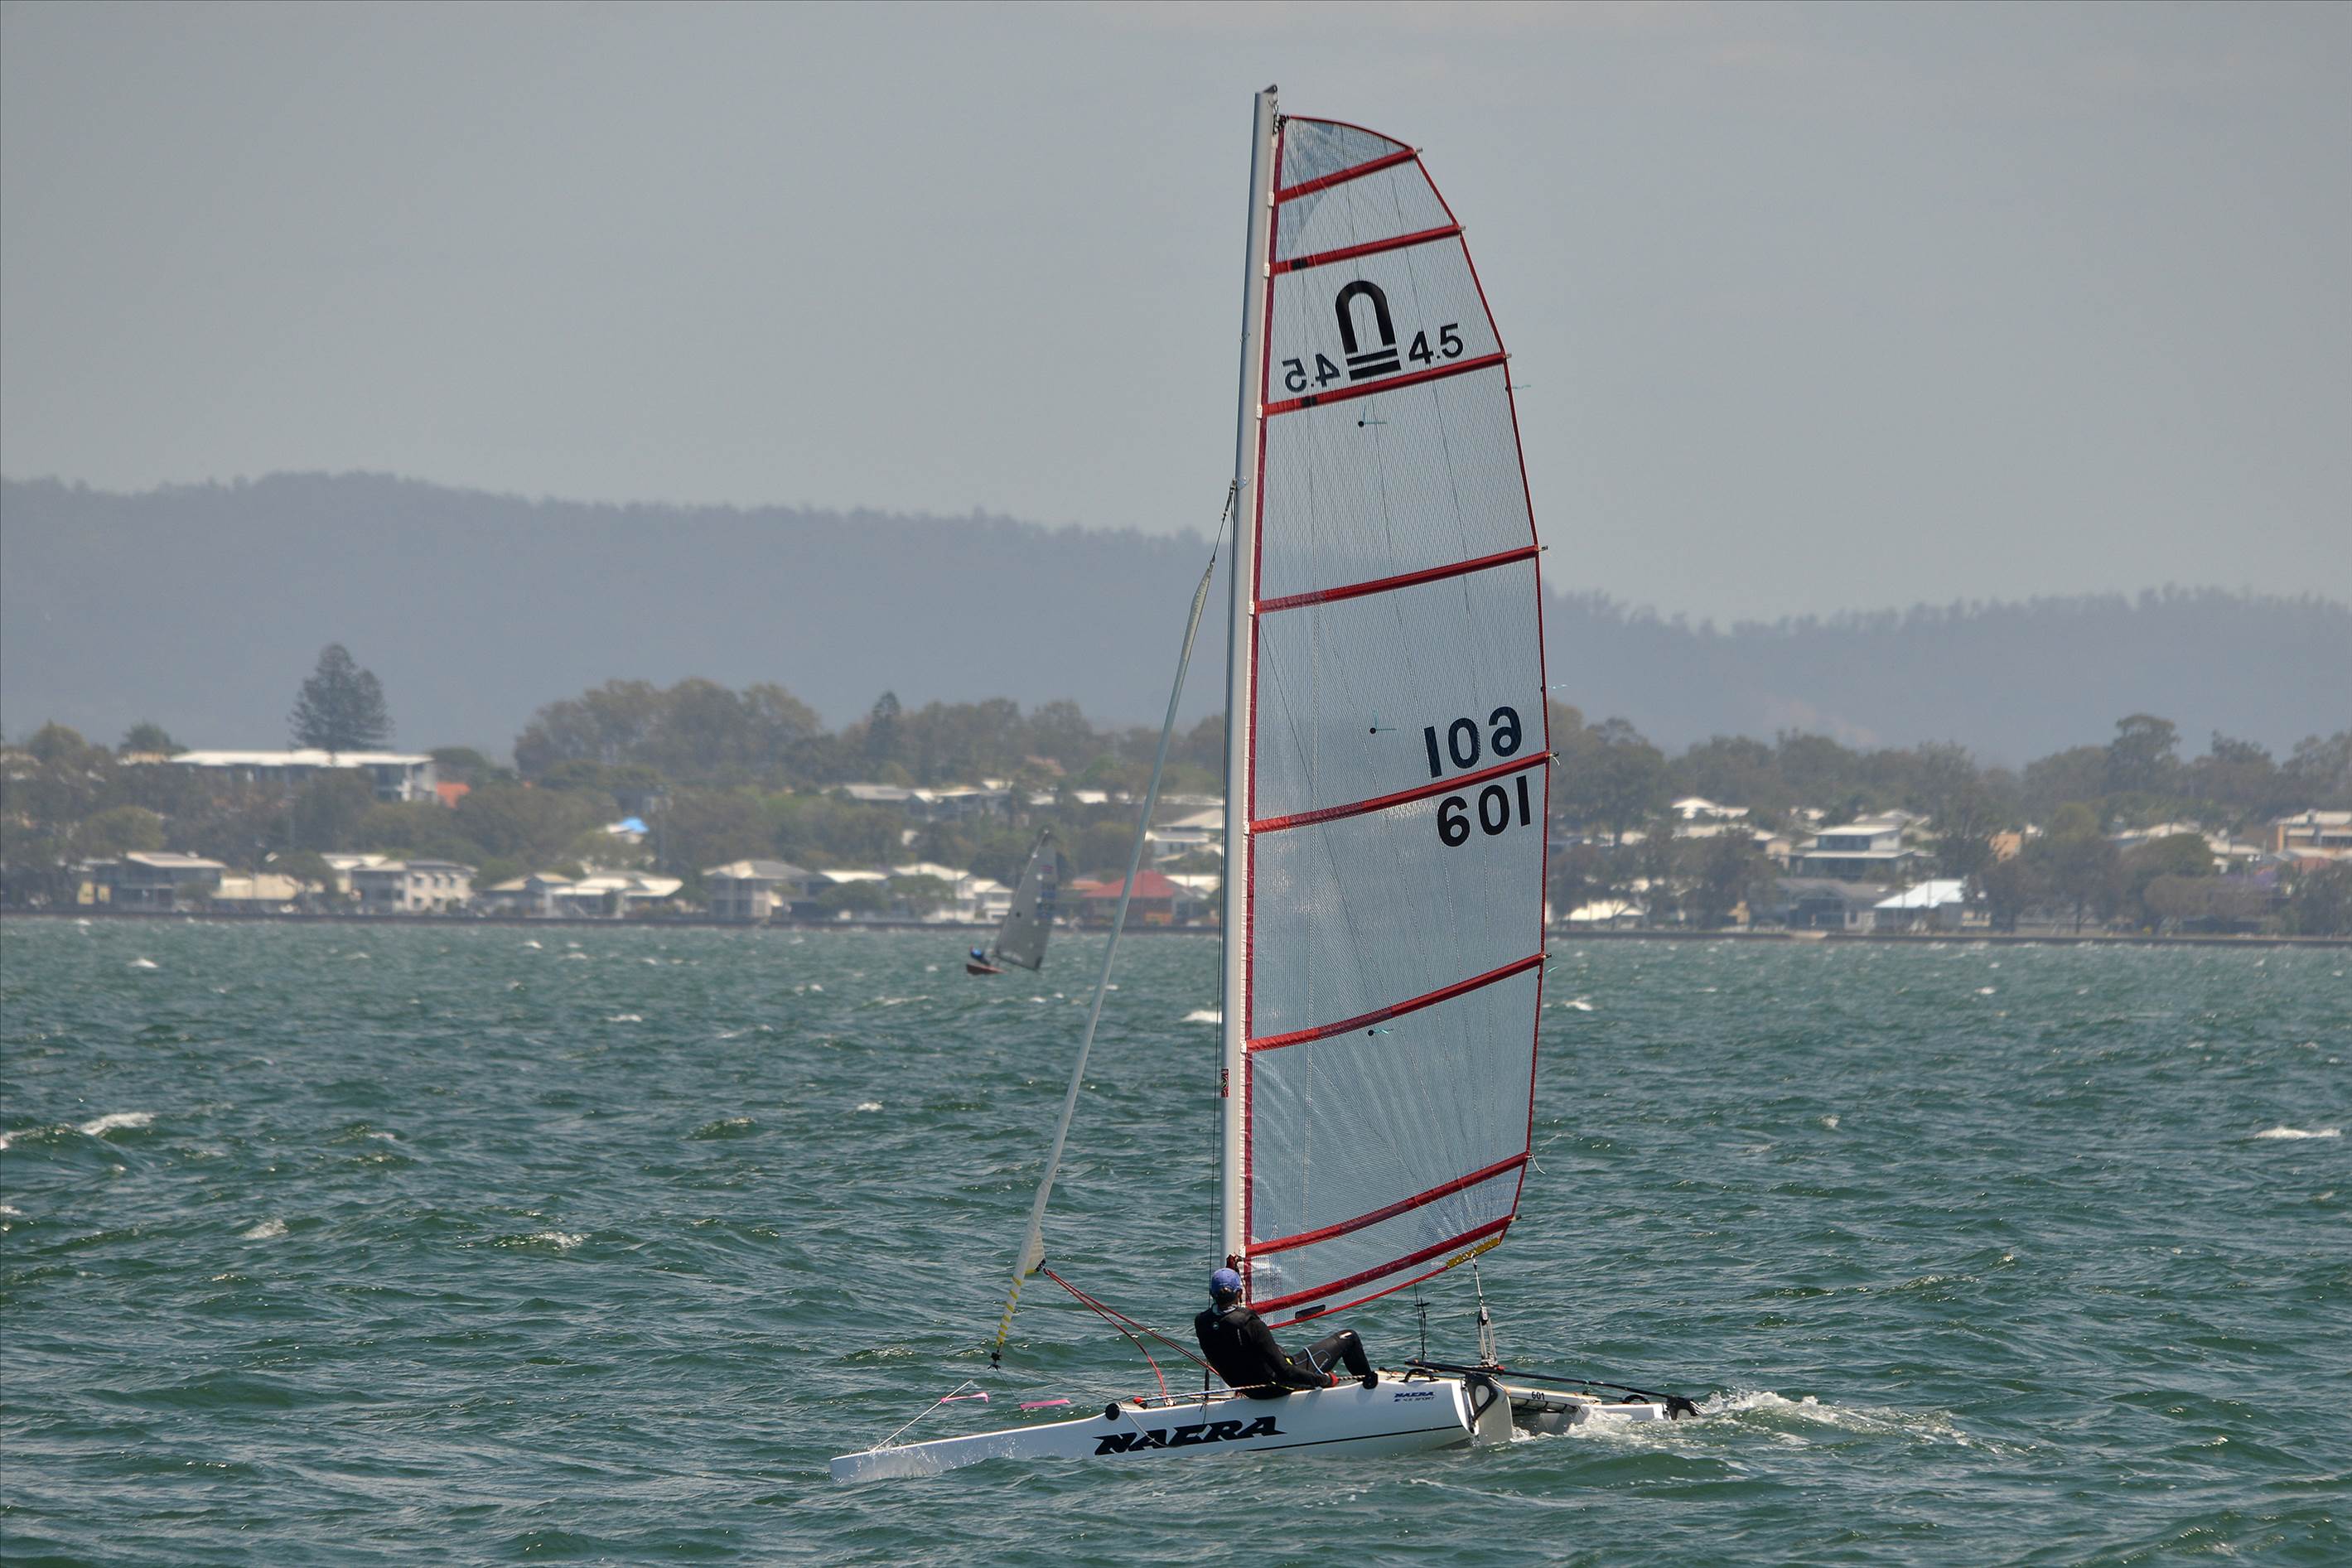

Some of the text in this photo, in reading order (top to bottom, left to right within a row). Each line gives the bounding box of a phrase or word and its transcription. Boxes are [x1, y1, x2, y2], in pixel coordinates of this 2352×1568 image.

[1409, 323, 1463, 364] 4.5
[1437, 774, 1531, 847] 601
[1531, 1391, 1545, 1400] 601
[1093, 1416, 1287, 1455] NACRA
